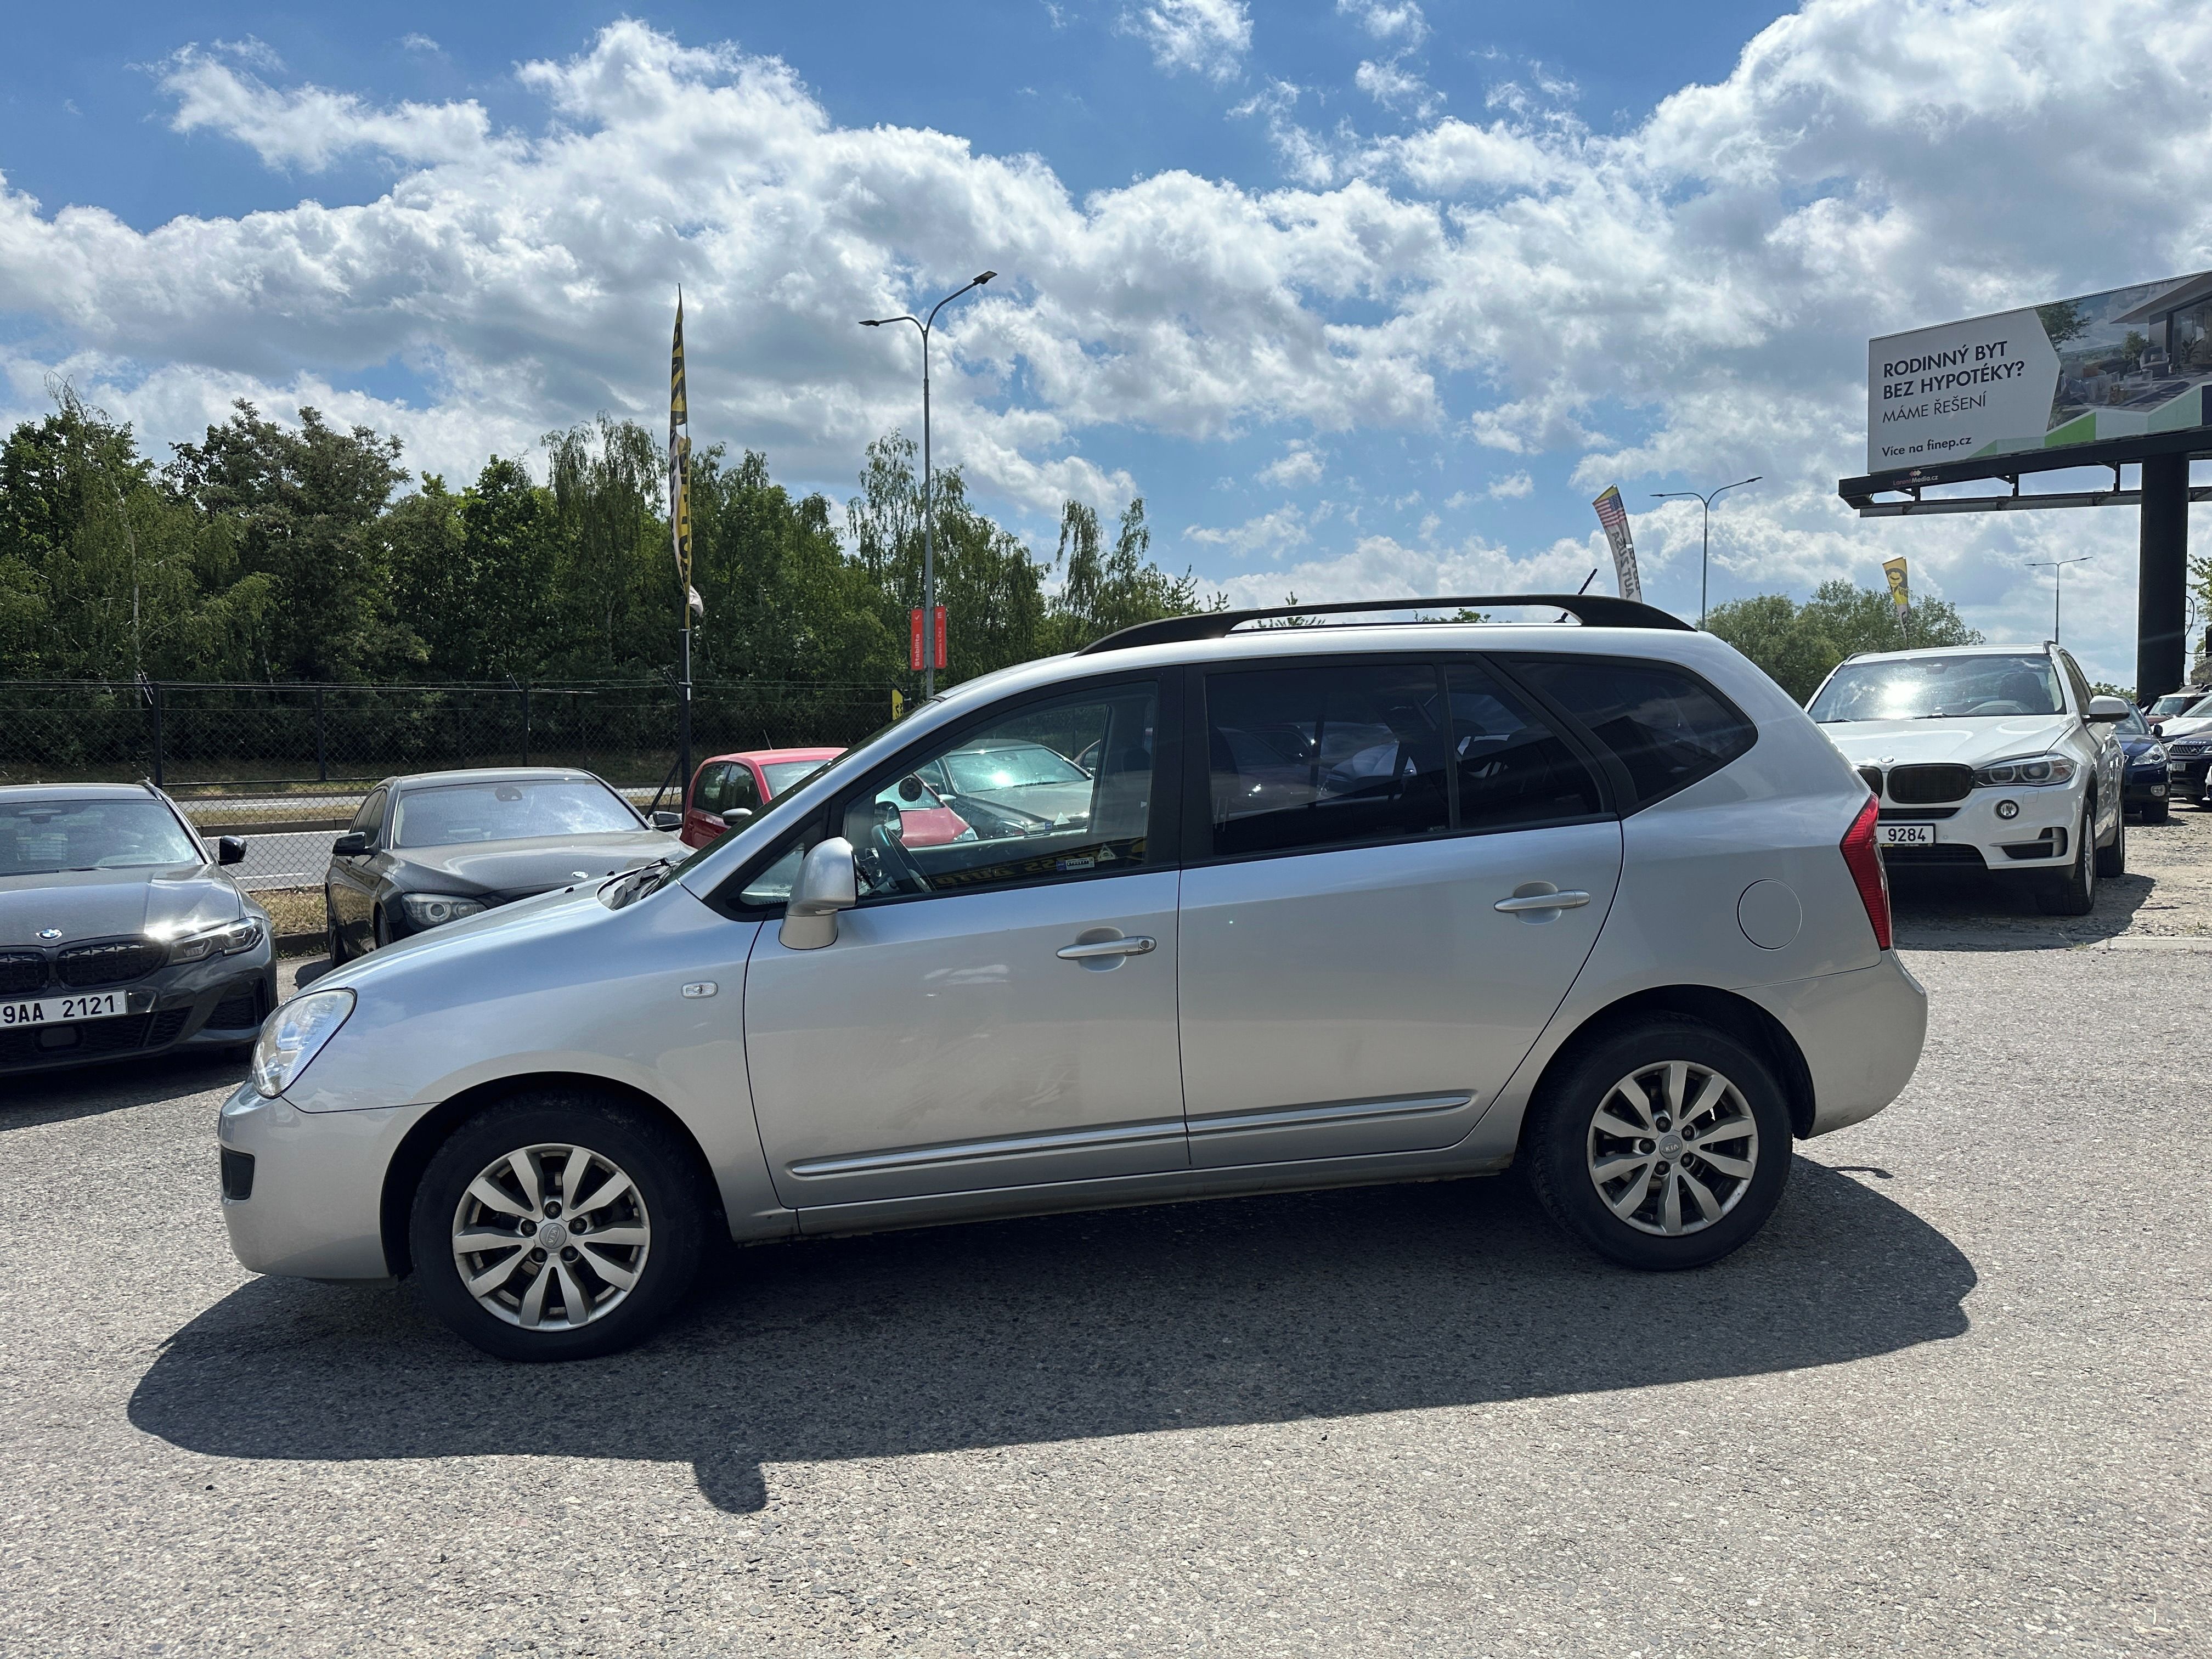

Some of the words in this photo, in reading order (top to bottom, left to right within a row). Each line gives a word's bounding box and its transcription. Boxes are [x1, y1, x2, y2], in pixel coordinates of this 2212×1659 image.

[1883, 344, 1970, 378] RODINNÝ
[1975, 340, 2008, 361] BYT
[1883, 380, 1915, 399] BEZ
[1921, 360, 2025, 393] HYPOTÉKY?
[1882, 404, 1929, 423] MÁME
[1934, 391, 1987, 415] ŘEŠENÍ
[1882, 445, 1905, 457] Více
[1909, 444, 1923, 454] na
[1927, 437, 1972, 450] finep.cz
[1888, 827, 1926, 842] 9284
[3, 1002, 44, 1024] 9AA
[61, 995, 115, 1018] 2121
[1665, 1144, 1679, 1152] KIA
[548, 1229, 558, 1243] KIA
